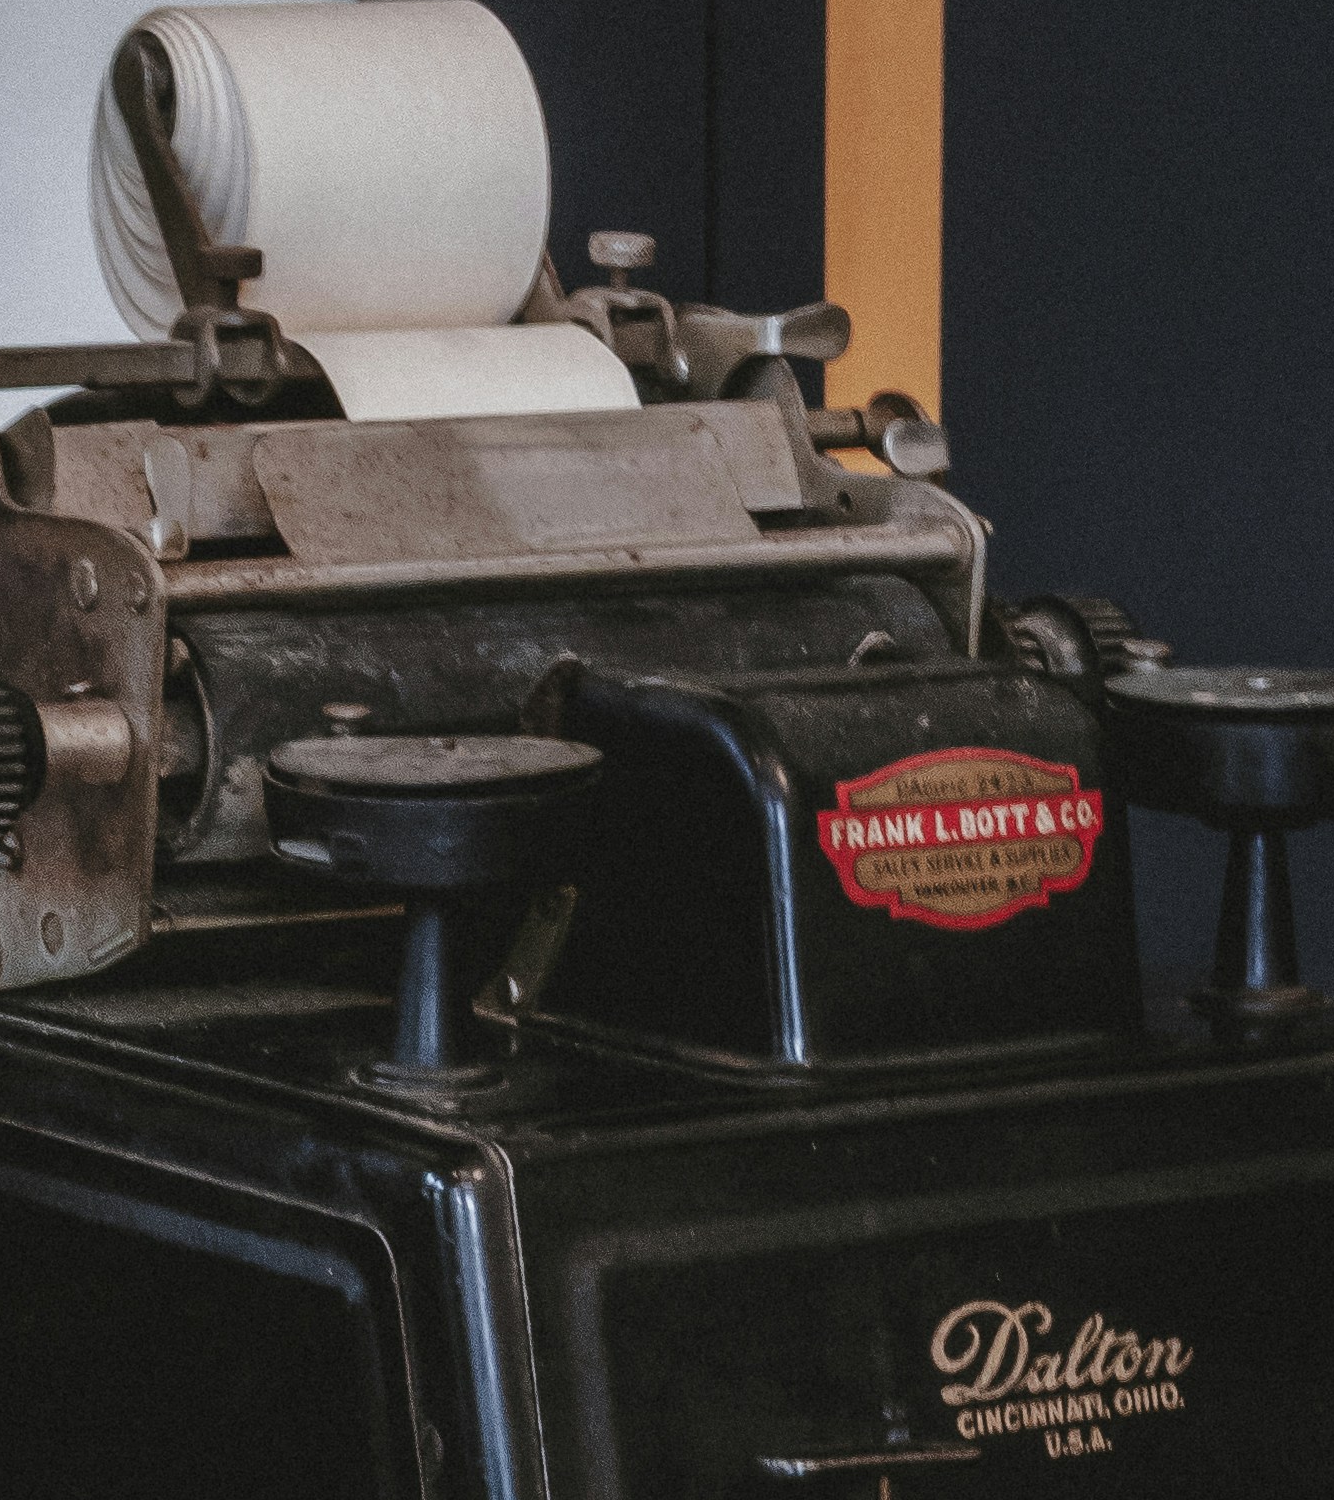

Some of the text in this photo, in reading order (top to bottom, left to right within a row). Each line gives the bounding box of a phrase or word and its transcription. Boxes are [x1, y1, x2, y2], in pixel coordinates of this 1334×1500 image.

[830, 812, 926, 850] FRANK
[1035, 802, 1056, 834] &
[930, 1300, 1194, 1406] Dalton
